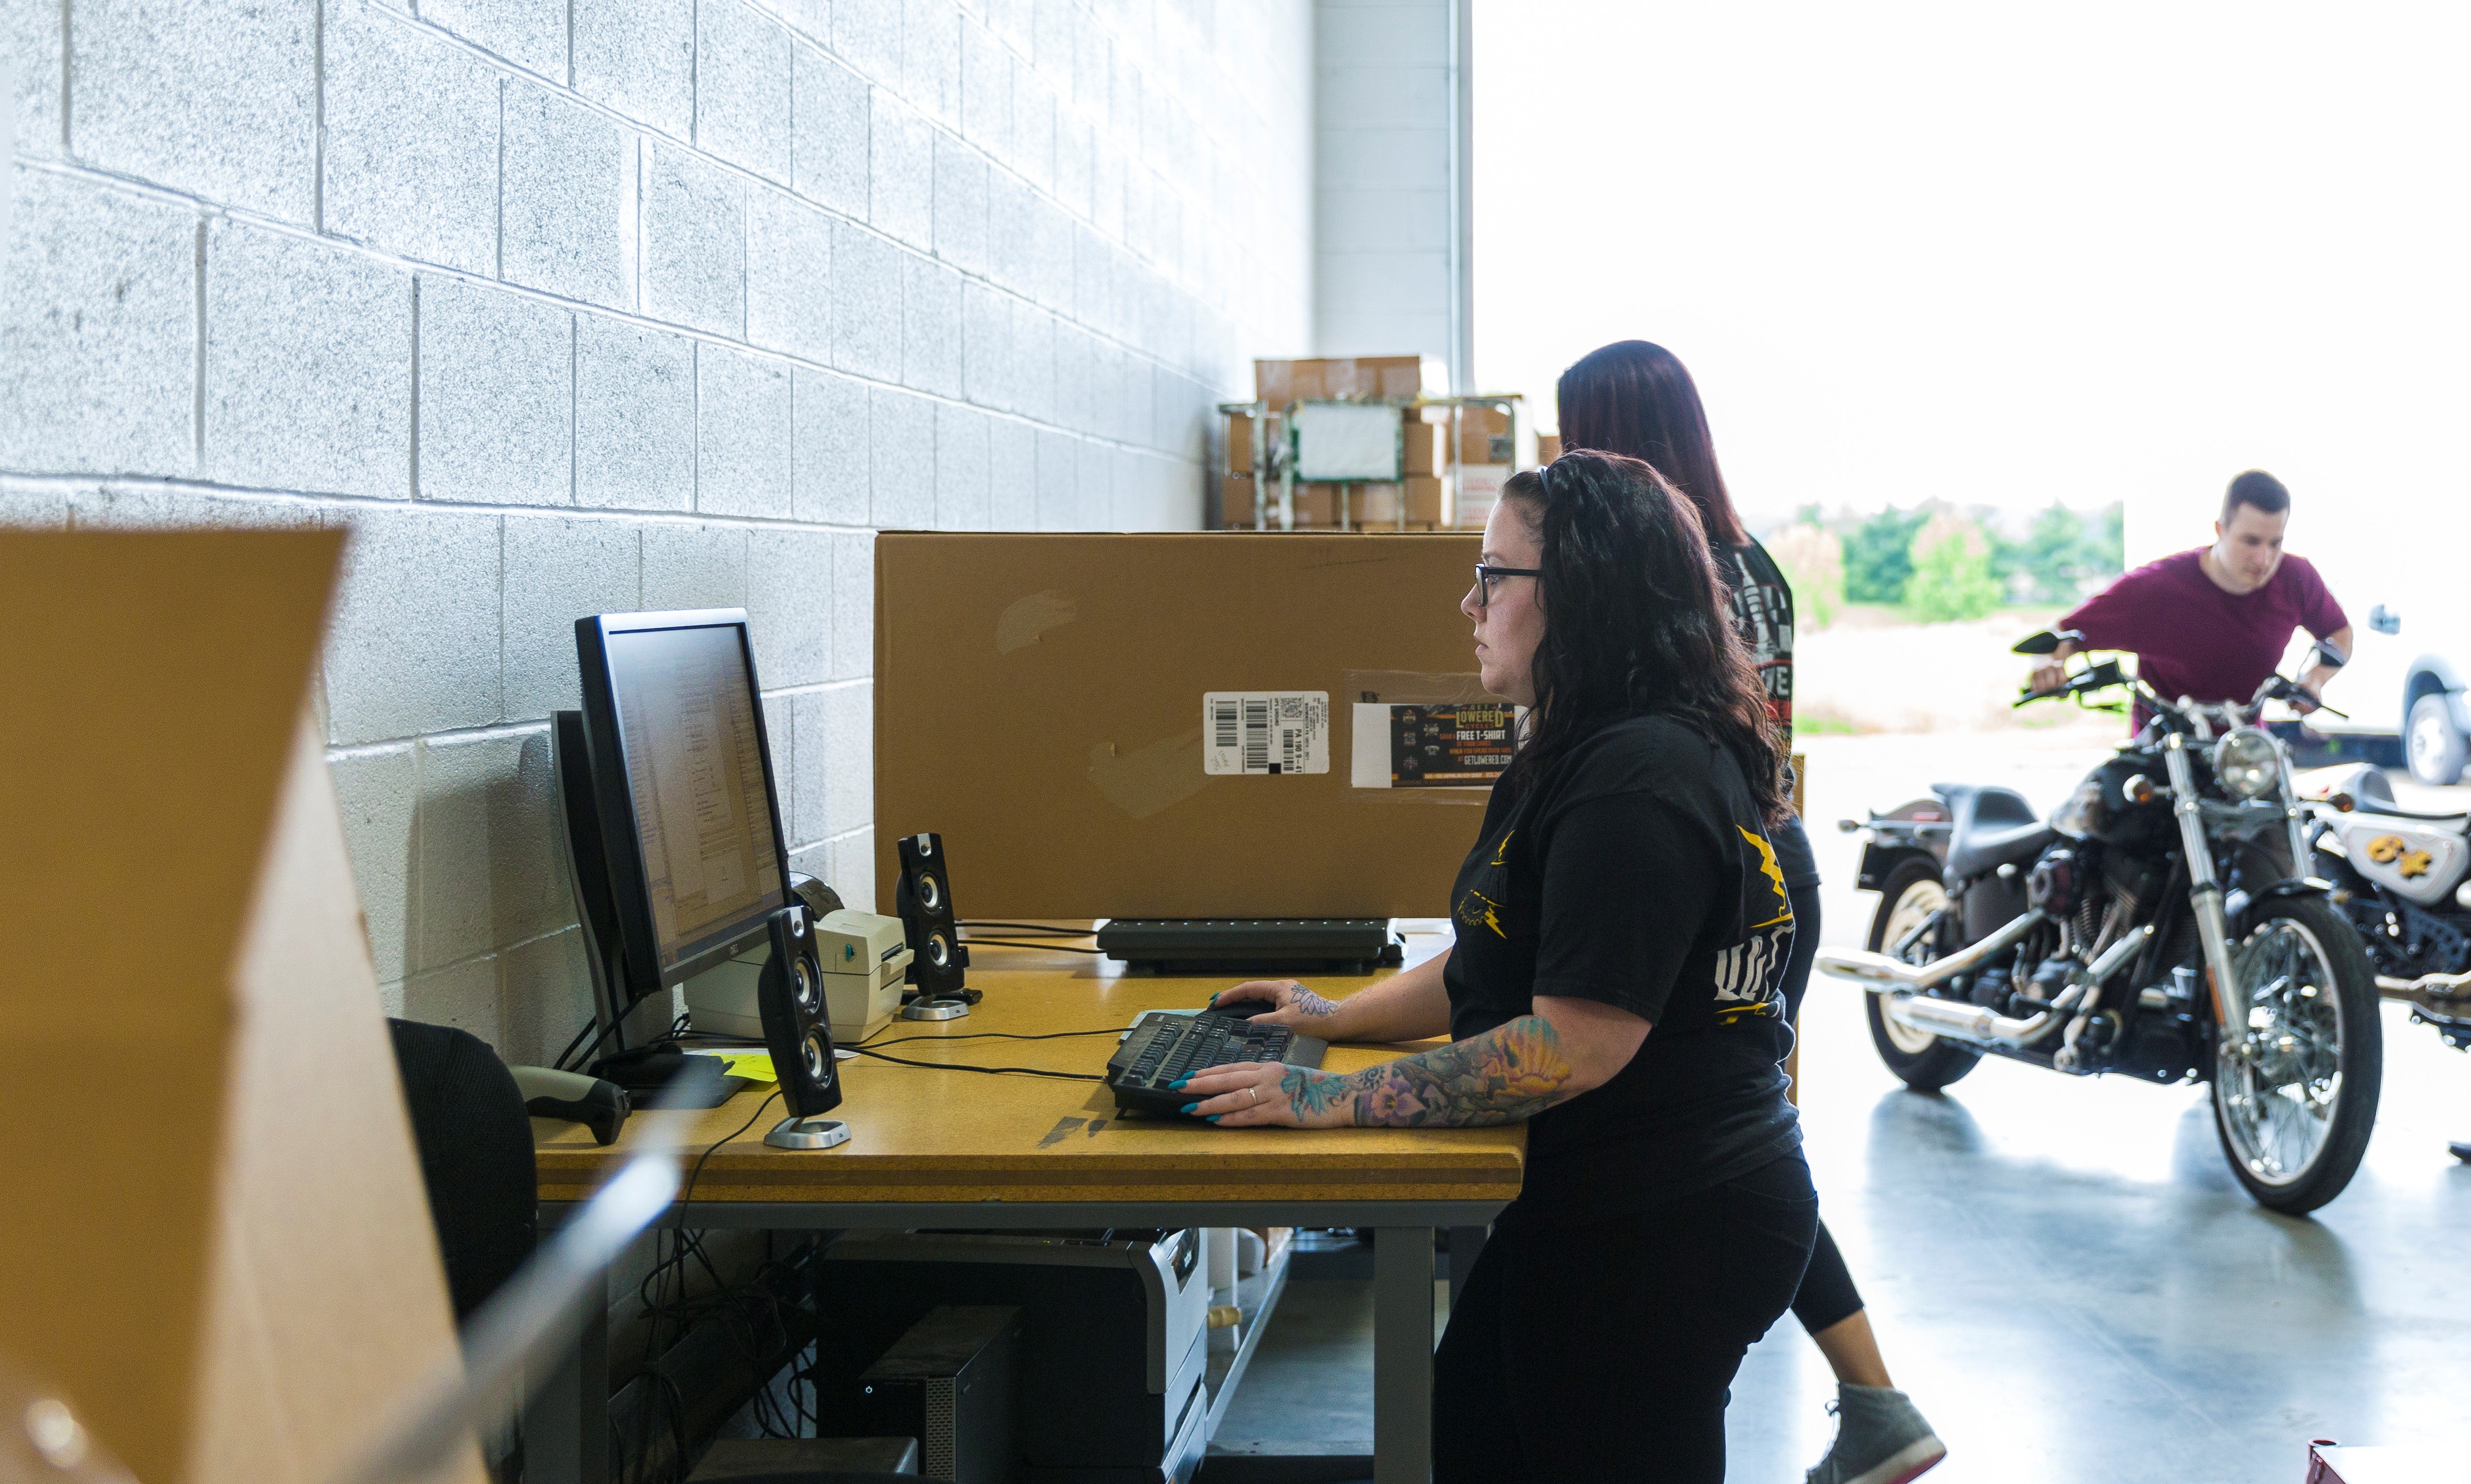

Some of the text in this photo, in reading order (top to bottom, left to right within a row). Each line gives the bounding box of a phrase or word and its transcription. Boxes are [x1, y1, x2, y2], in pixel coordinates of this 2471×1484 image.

[1455, 710, 1504, 729] LOWERED
[1295, 729, 1302, 737] PA
[1456, 730, 1475, 740] FREE
[1476, 730, 1505, 740] T-SHIRT
[1464, 755, 1512, 765] GETLOWERED.COM
